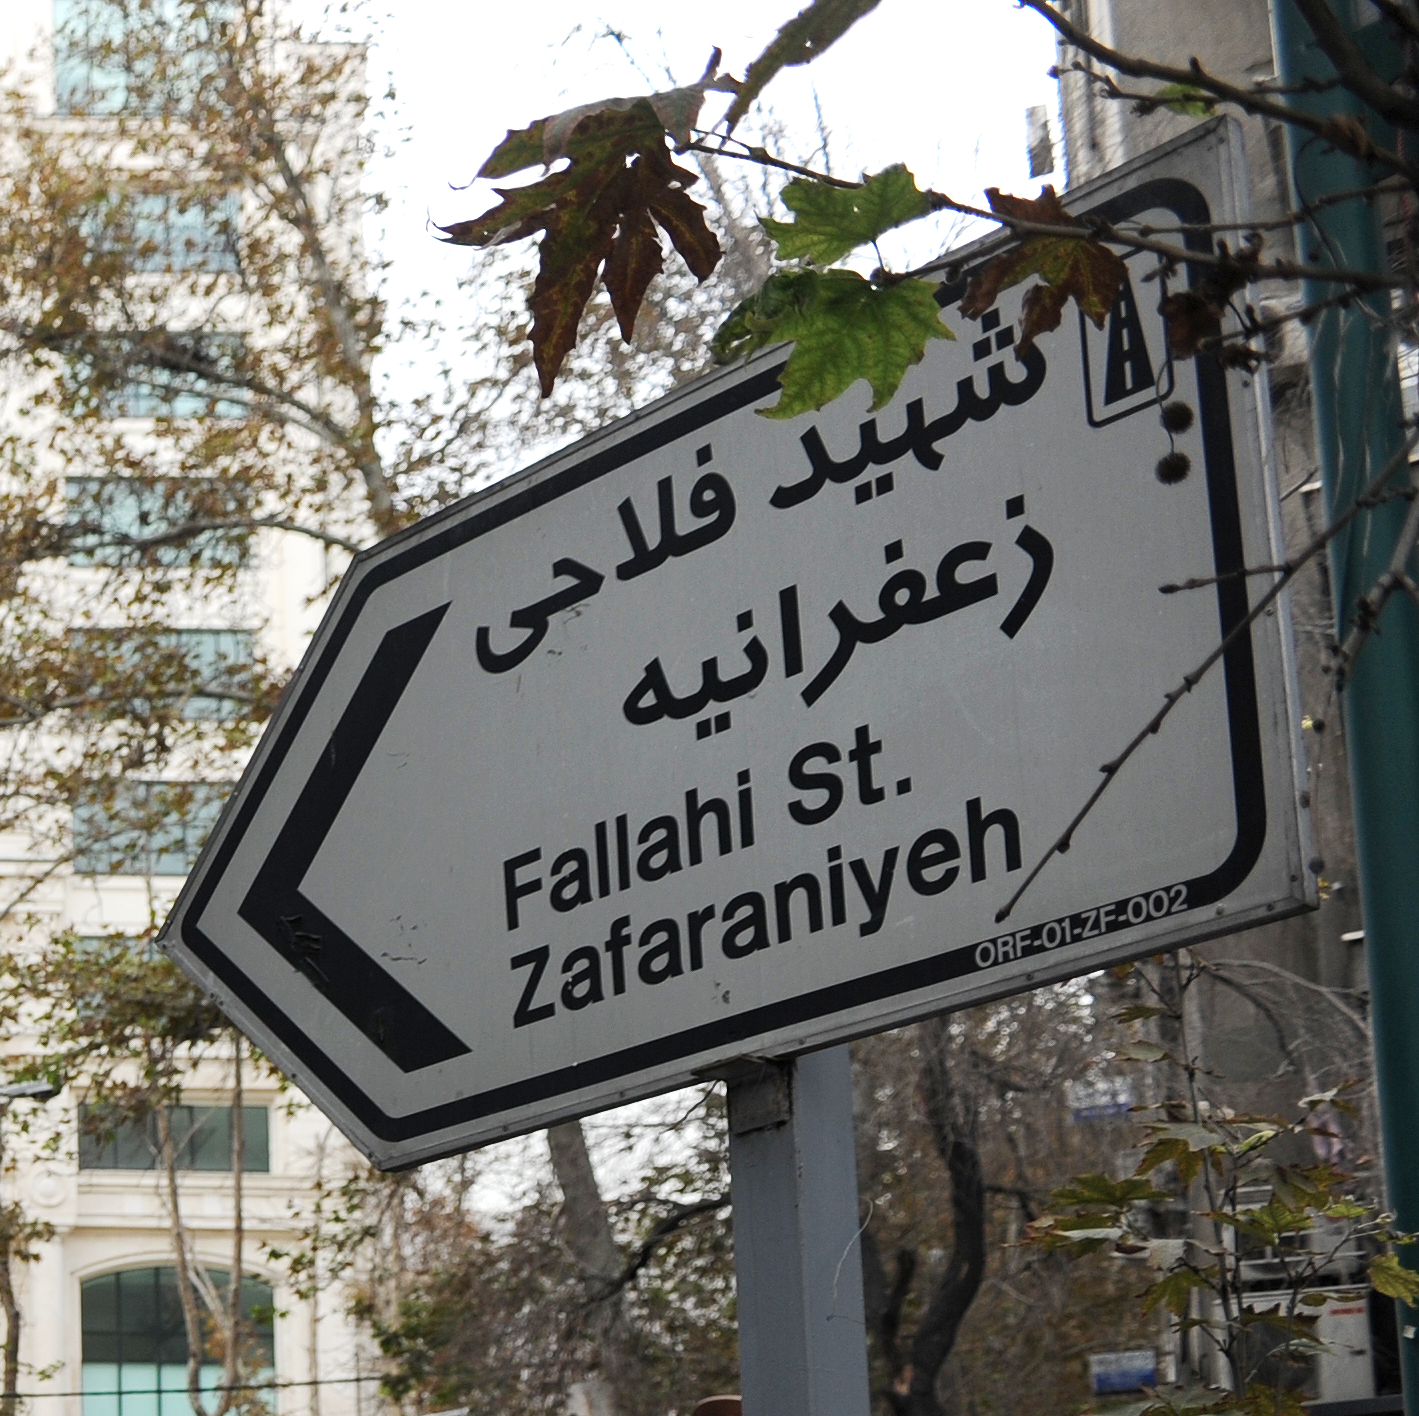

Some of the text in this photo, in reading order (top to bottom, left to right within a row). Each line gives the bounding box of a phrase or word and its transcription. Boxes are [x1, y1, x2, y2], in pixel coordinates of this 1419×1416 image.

[476, 308, 1048, 674] شهید فلاحی
[623, 495, 1054, 741] زعفرانیه
[503, 725, 912, 932] Fallahi St.
[510, 797, 1022, 1029] Zafaraniyeh
